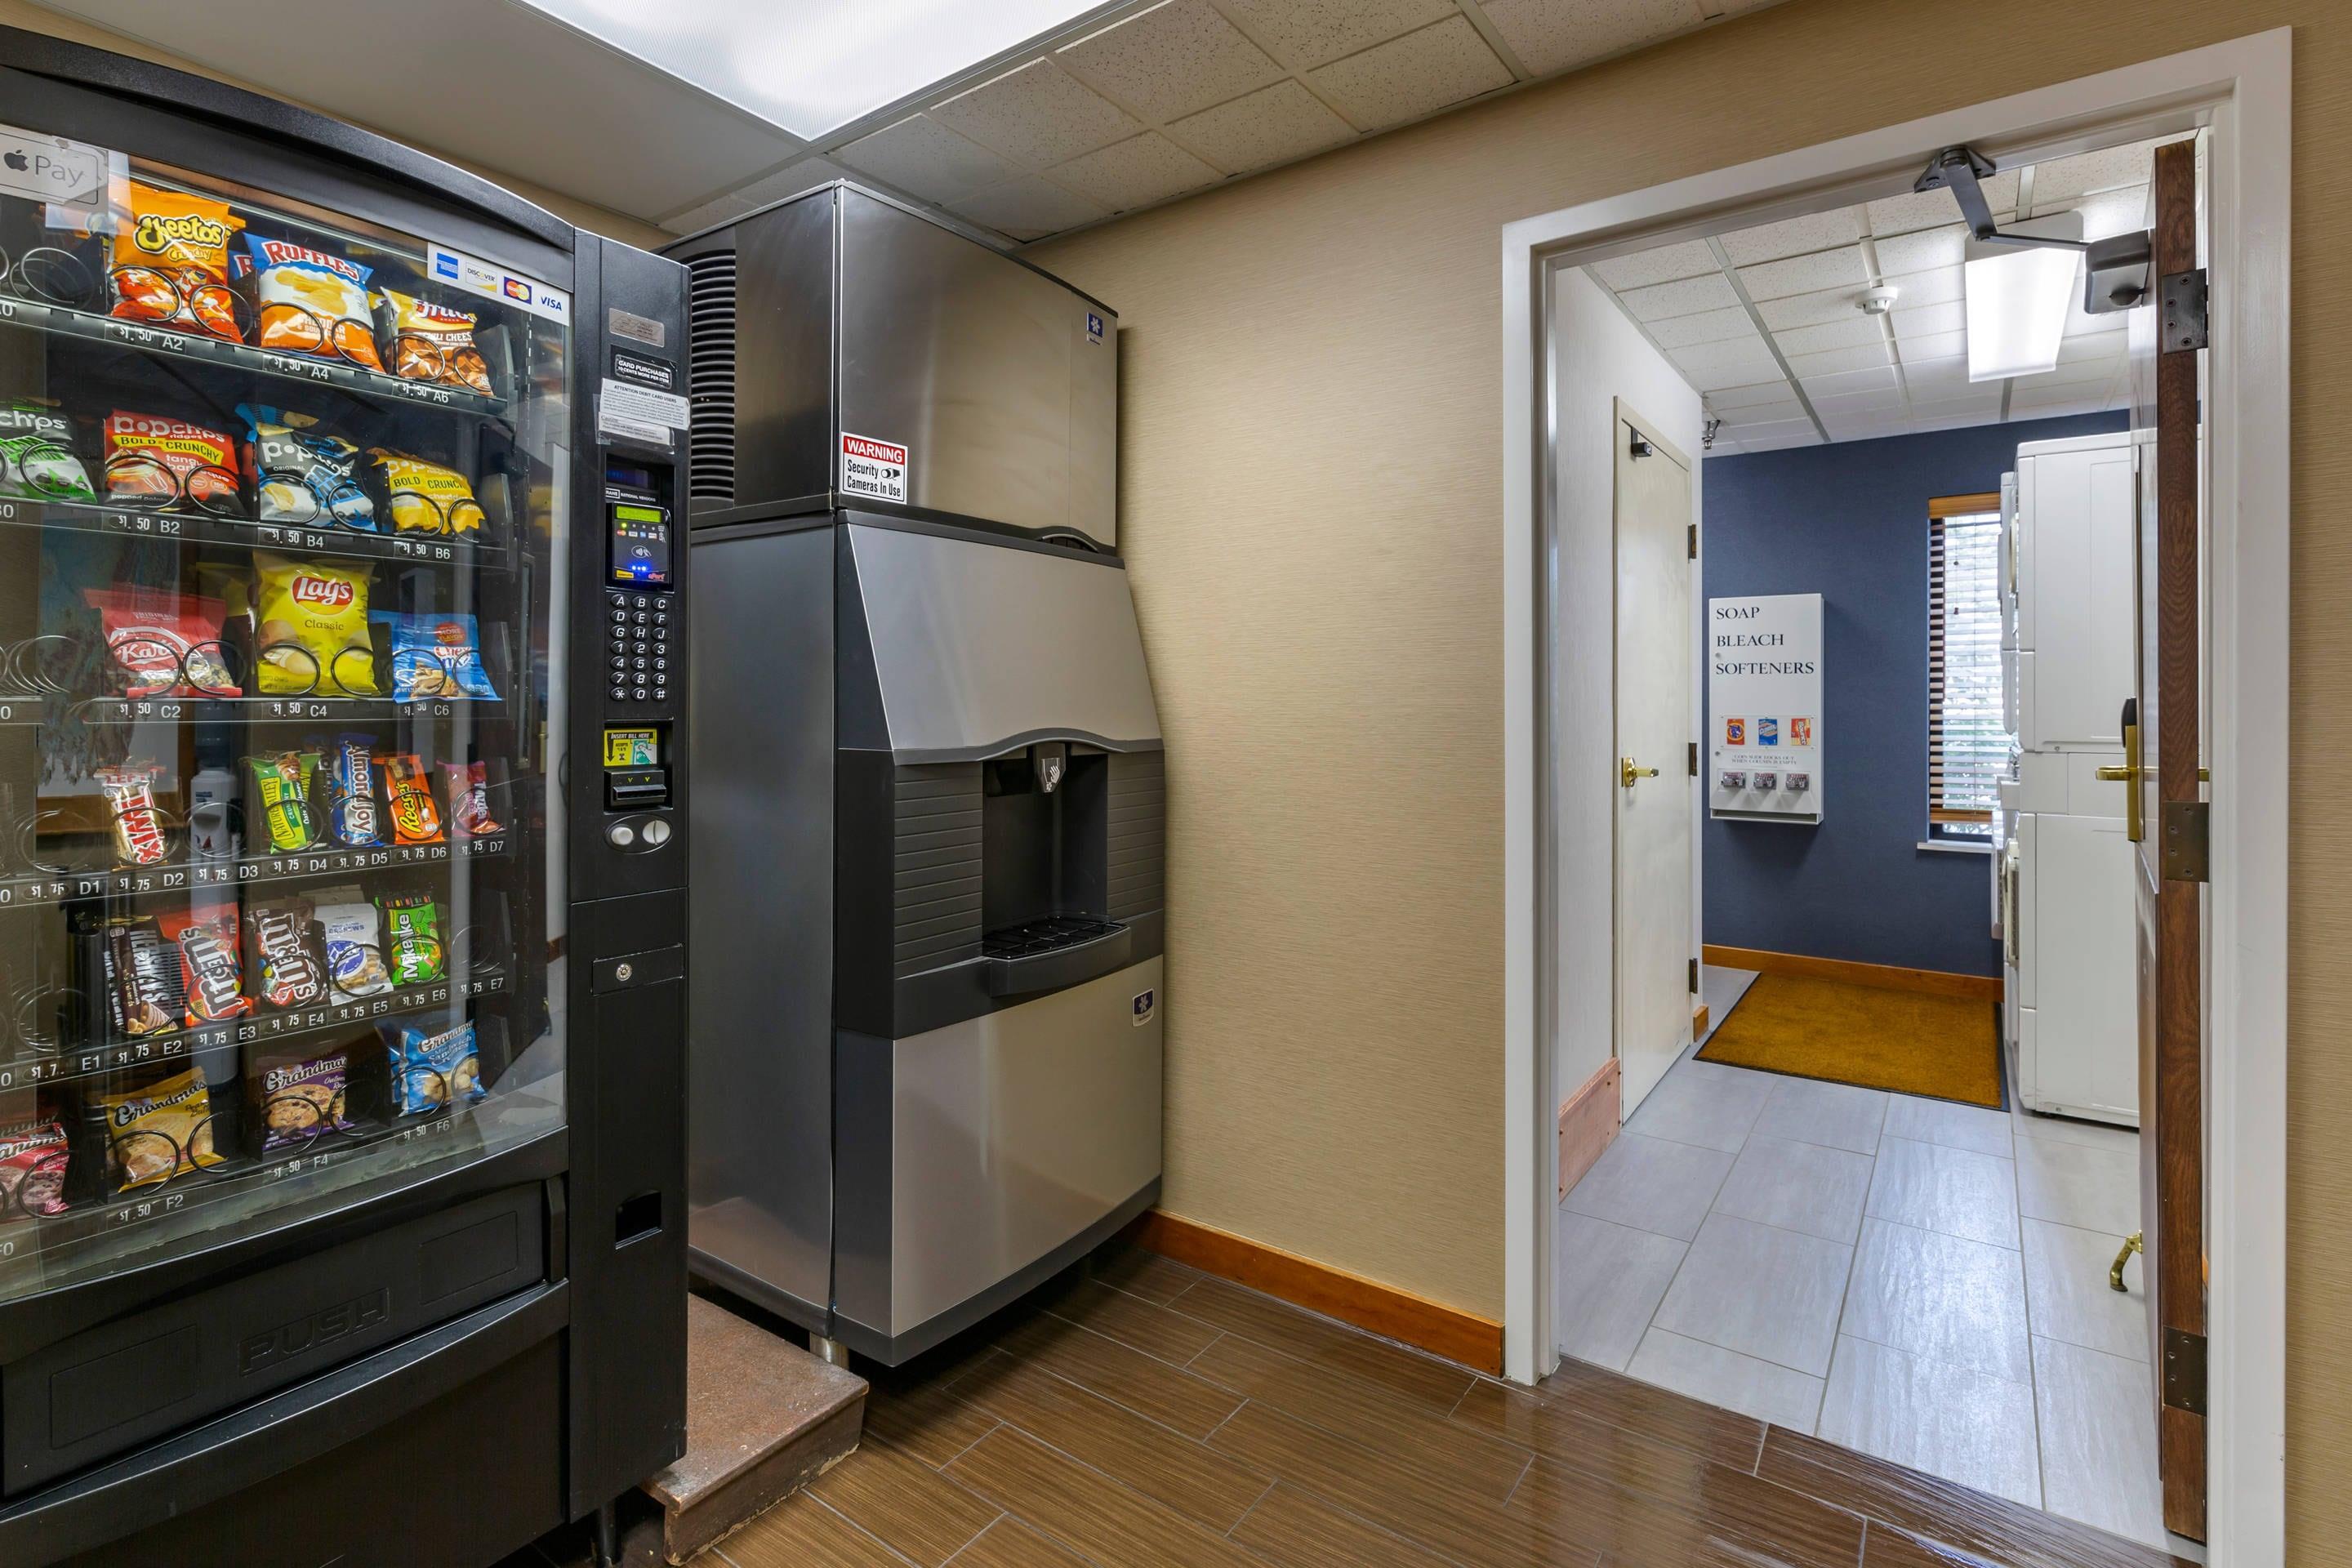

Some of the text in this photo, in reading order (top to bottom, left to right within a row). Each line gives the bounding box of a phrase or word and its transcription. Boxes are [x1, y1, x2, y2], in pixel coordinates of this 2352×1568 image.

[35, 154, 84, 188] Pay
[136, 215, 225, 252] Cheetos
[261, 240, 360, 282] RUFFLES
[467, 268, 496, 282] DISCOVER
[541, 296, 562, 311] VISA
[162, 336, 183, 351] A2
[311, 367, 329, 380] A4
[618, 360, 669, 379] CARD PURCHASES
[614, 385, 639, 394] ATTENTION
[433, 390, 450, 403] A6
[120, 437, 220, 461] BOLD CRUNCHY
[847, 439, 902, 463] WARNING
[848, 459, 879, 479] Security
[394, 476, 421, 488] BOLD
[847, 475, 901, 497] Cameras In Use
[160, 520, 180, 534] B2
[307, 535, 324, 547] B4
[435, 548, 451, 559] B6
[296, 577, 350, 605] Lay's
[617, 596, 666, 608] A B C
[617, 612, 666, 623] D E F
[1716, 607, 1760, 620] SOAP
[305, 620, 344, 630] Classic
[617, 627, 665, 639] G H J
[1717, 634, 1784, 647] BLEACH
[617, 644, 665, 654] 1 2 3
[617, 658, 665, 669] 4 5 6
[1716, 662, 1814, 675] SOFTENERS
[617, 674, 665, 684] 7 8 9
[637, 690, 666, 699] 0 #
[161, 706, 181, 718] C2
[310, 705, 327, 717] C4
[434, 705, 449, 716] C6
[261, 778, 292, 840] NATURE ALLEY
[283, 792, 295, 819] CRUNHY
[395, 782, 423, 833] Reese's
[119, 794, 164, 862] TWIX
[431, 844, 447, 858] D6
[490, 841, 504, 853] D7
[310, 858, 327, 871] D4
[372, 852, 388, 865] D5
[239, 866, 259, 879] D3
[163, 873, 184, 887] D2
[79, 881, 100, 895] D1
[129, 929, 170, 1004] HERSHEY'S
[490, 978, 504, 990] E7
[432, 989, 447, 1001] E6
[373, 1001, 388, 1013] E5
[309, 1013, 324, 1026] E4
[239, 1027, 256, 1040] E3
[163, 1041, 182, 1054] E2
[31, 1056, 100, 1079] $1.7 E1
[113, 1080, 207, 1127] Grandma's
[436, 1121, 449, 1134] F6
[314, 1155, 328, 1169] F4
[166, 1195, 183, 1210] F2
[243, 1300, 385, 1375] PUSH
